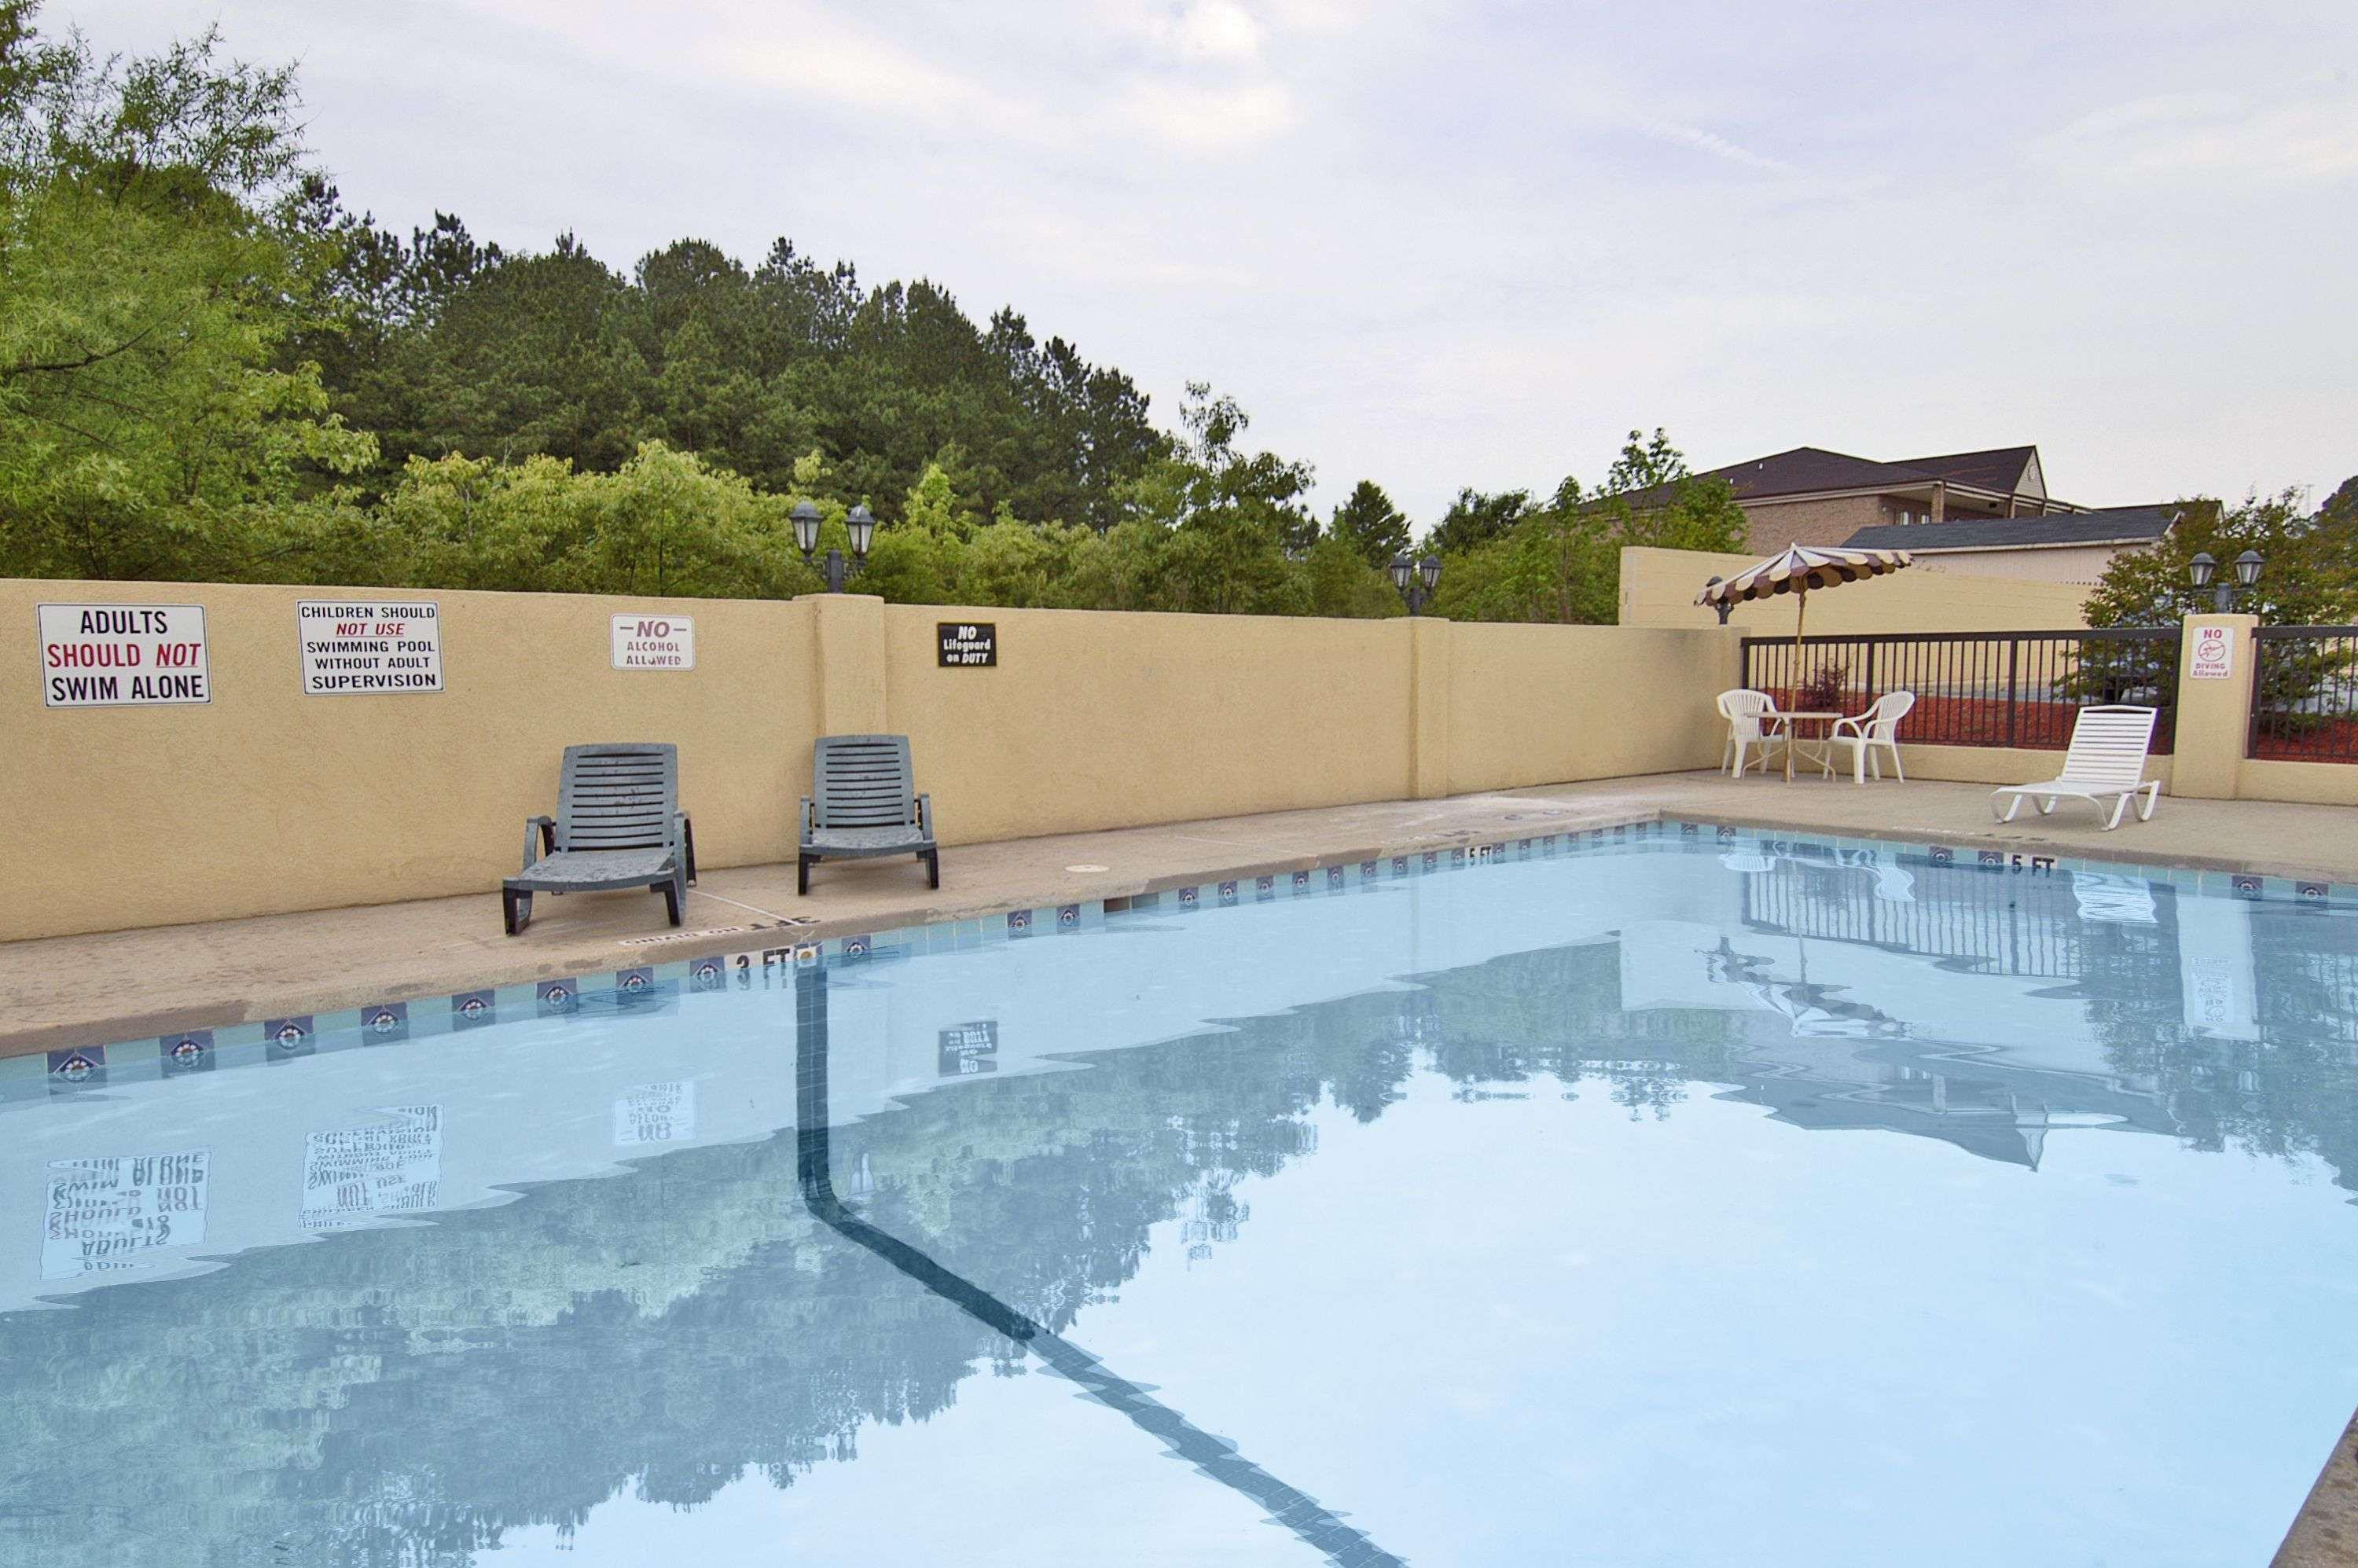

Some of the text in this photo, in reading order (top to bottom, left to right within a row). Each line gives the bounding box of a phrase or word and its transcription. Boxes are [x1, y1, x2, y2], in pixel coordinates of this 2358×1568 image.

[302, 607, 435, 619] CHILDREN SHOULD
[80, 611, 167, 633] ADULTS
[637, 621, 670, 637] NO
[336, 623, 406, 636] NOT USE
[957, 626, 977, 640] NO
[2203, 630, 2222, 638] NO
[307, 641, 435, 652] SWIMMING POOL
[627, 641, 679, 652] ALCOHOL
[943, 637, 991, 652] Lifeguard
[47, 643, 201, 667] SHOULD NOT
[946, 652, 989, 664] on DUTY
[315, 657, 430, 669] WITHOUT ADULT
[52, 675, 204, 701] SWIM ALONE
[312, 674, 436, 689] SUPERVISION
[2032, 857, 2055, 876] FT
